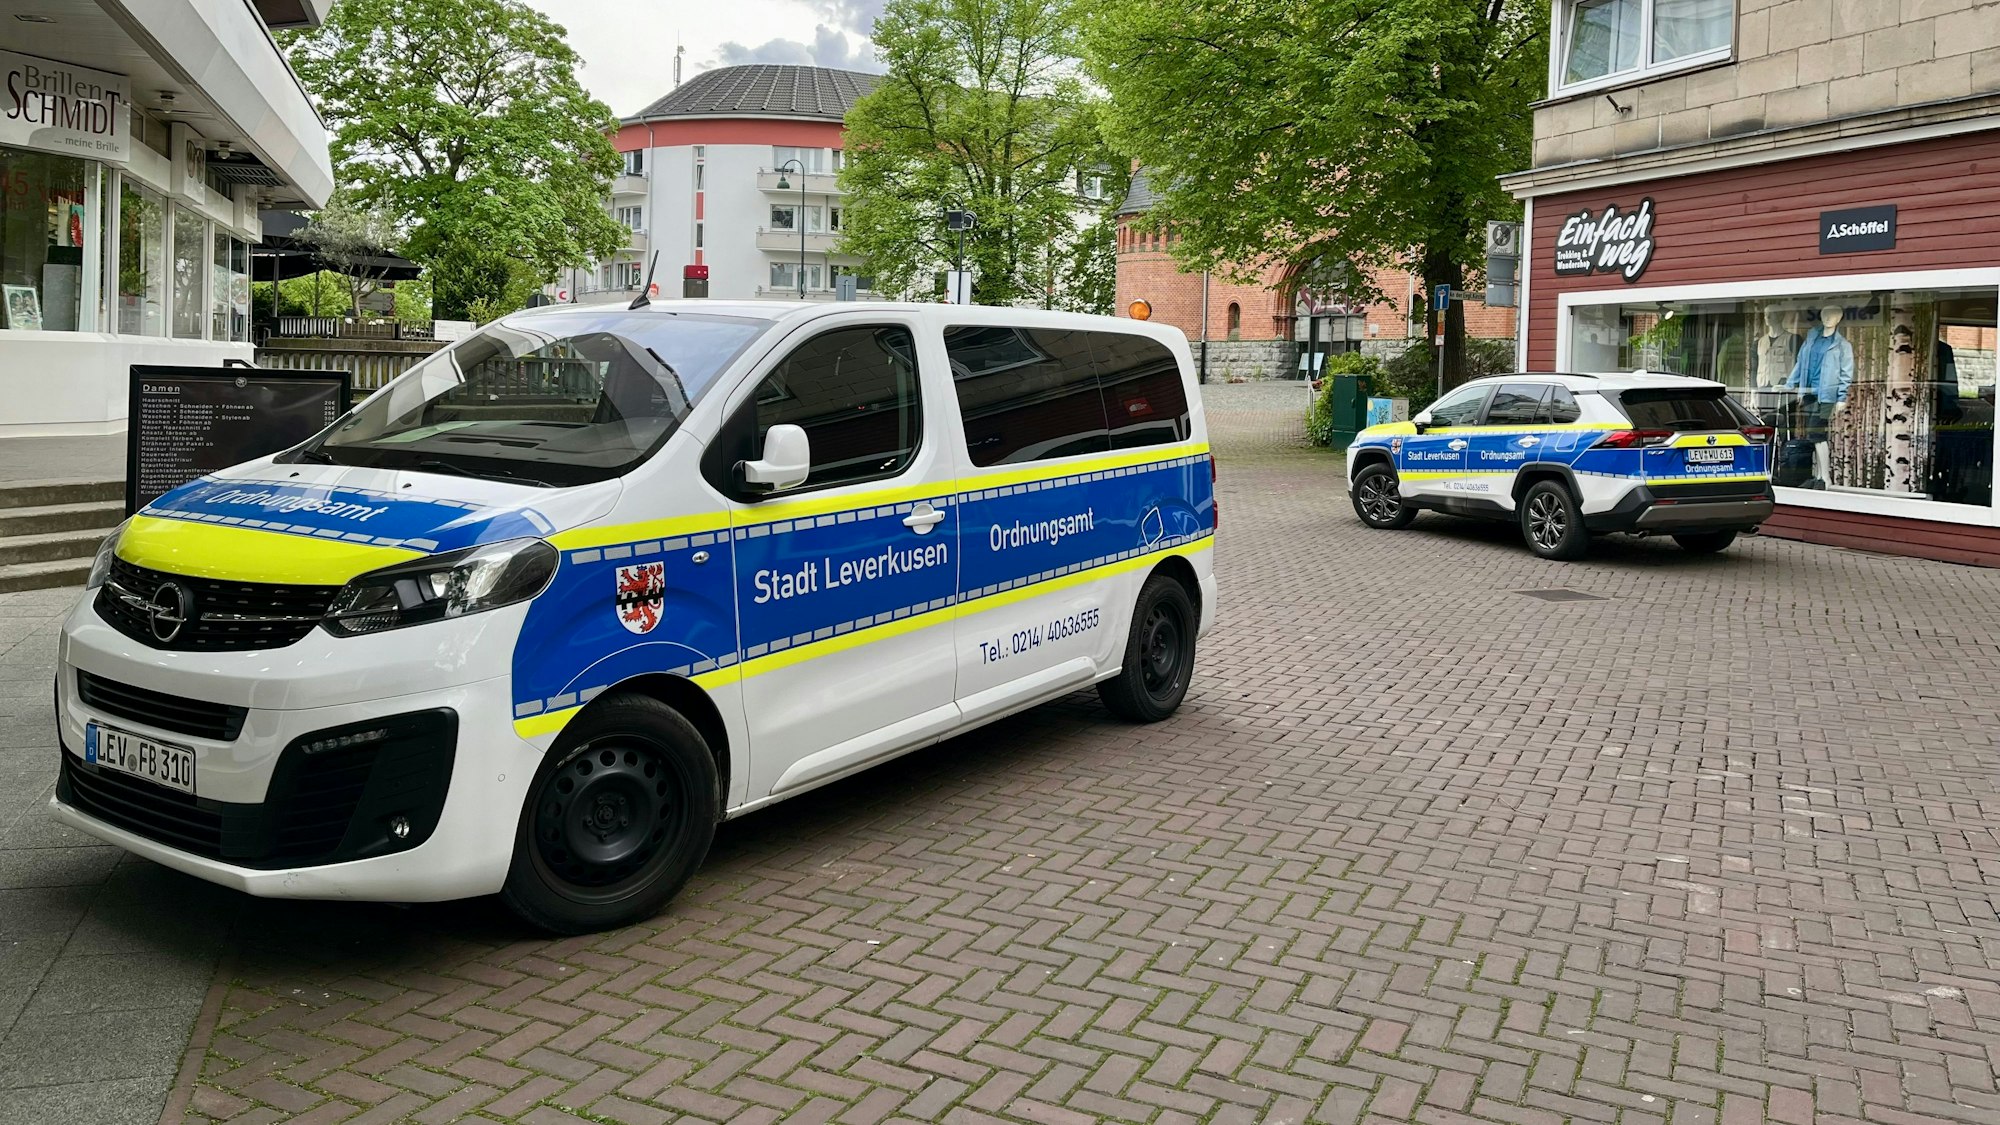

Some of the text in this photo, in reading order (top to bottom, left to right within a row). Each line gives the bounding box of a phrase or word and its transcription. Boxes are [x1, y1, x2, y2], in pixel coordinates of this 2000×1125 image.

[23, 64, 101, 100] Brillen
[7, 71, 120, 136] SCHMIDT
[65, 137, 93, 149] meine
[96, 141, 119, 152] Brille
[1558, 201, 1651, 256] Einfach
[1839, 221, 1888, 237] Schöffel
[1557, 249, 1588, 260] Trekking &
[1557, 260, 1590, 270] Wandershop
[1599, 240, 1651, 277] weg
[142, 384, 180, 392] Damen
[1408, 451, 1459, 460] Stadt Leverkusen
[1481, 450, 1525, 462] Ordnungsamt
[1689, 448, 1732, 460] LEV WU 613
[1685, 464, 1733, 473] Ordnungsamt
[205, 489, 388, 522] Ordnungsamt
[990, 507, 1094, 551] Ordnungsamt
[754, 543, 947, 604] Stadt Leverkusen
[980, 608, 1099, 664] Tel.: 0214/ 40636555
[97, 731, 190, 786] LEV FB 310
